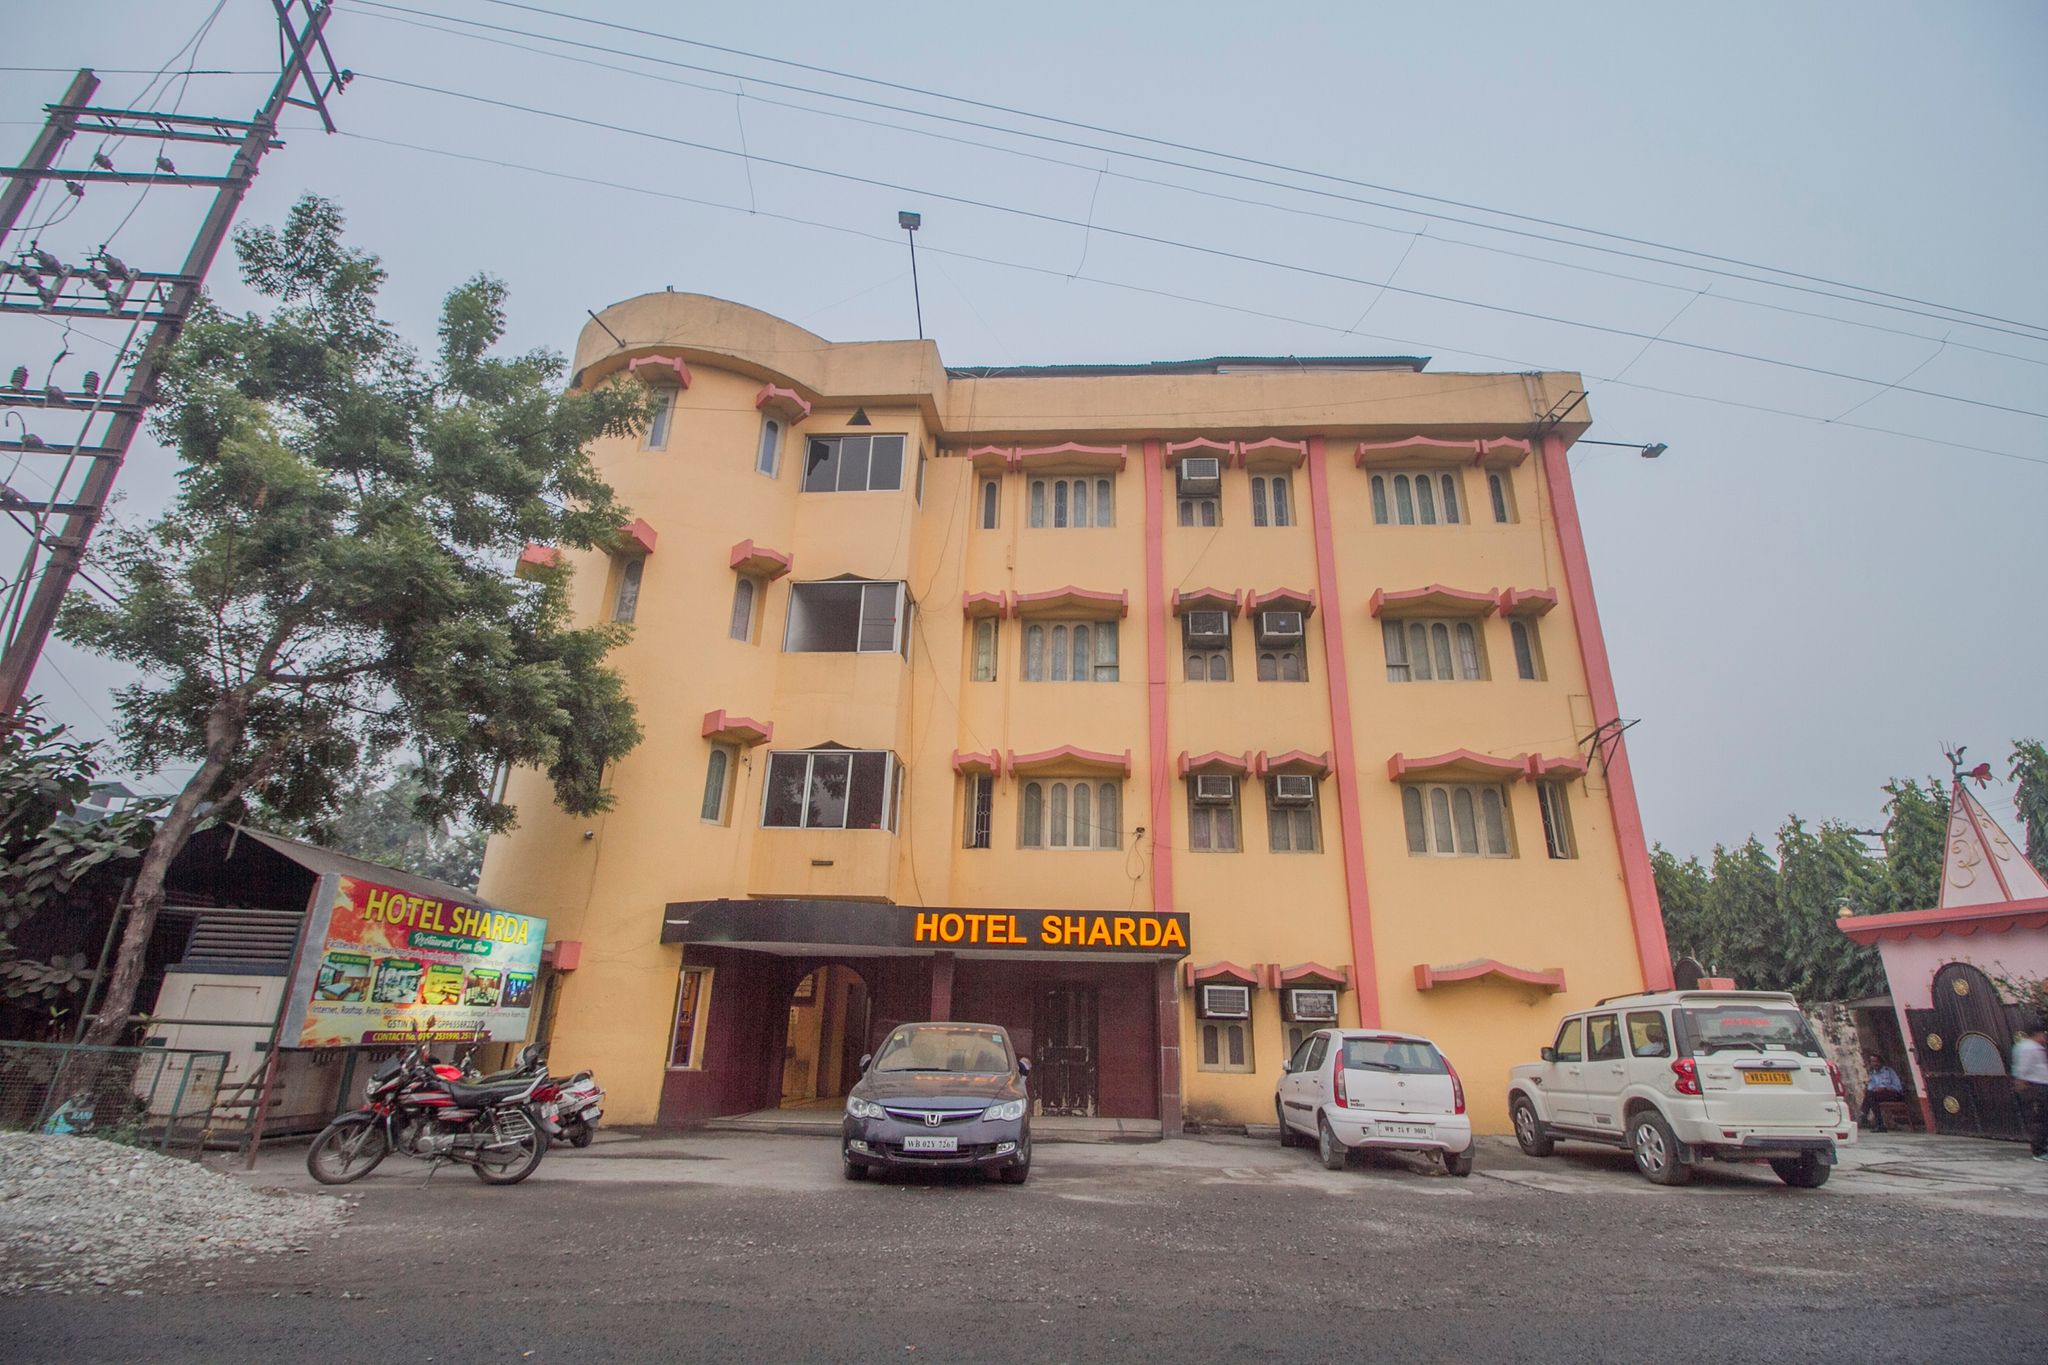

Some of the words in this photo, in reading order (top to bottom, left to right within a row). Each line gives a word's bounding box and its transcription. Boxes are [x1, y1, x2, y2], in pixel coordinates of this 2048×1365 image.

[363, 888, 446, 932] HOTEL
[448, 906, 529, 945] SHARDA
[915, 912, 1027, 944] HOTEL
[1041, 915, 1186, 947] SHARDA
[372, 1032, 406, 1041] CONTACT
[908, 1139, 920, 1147] WB
